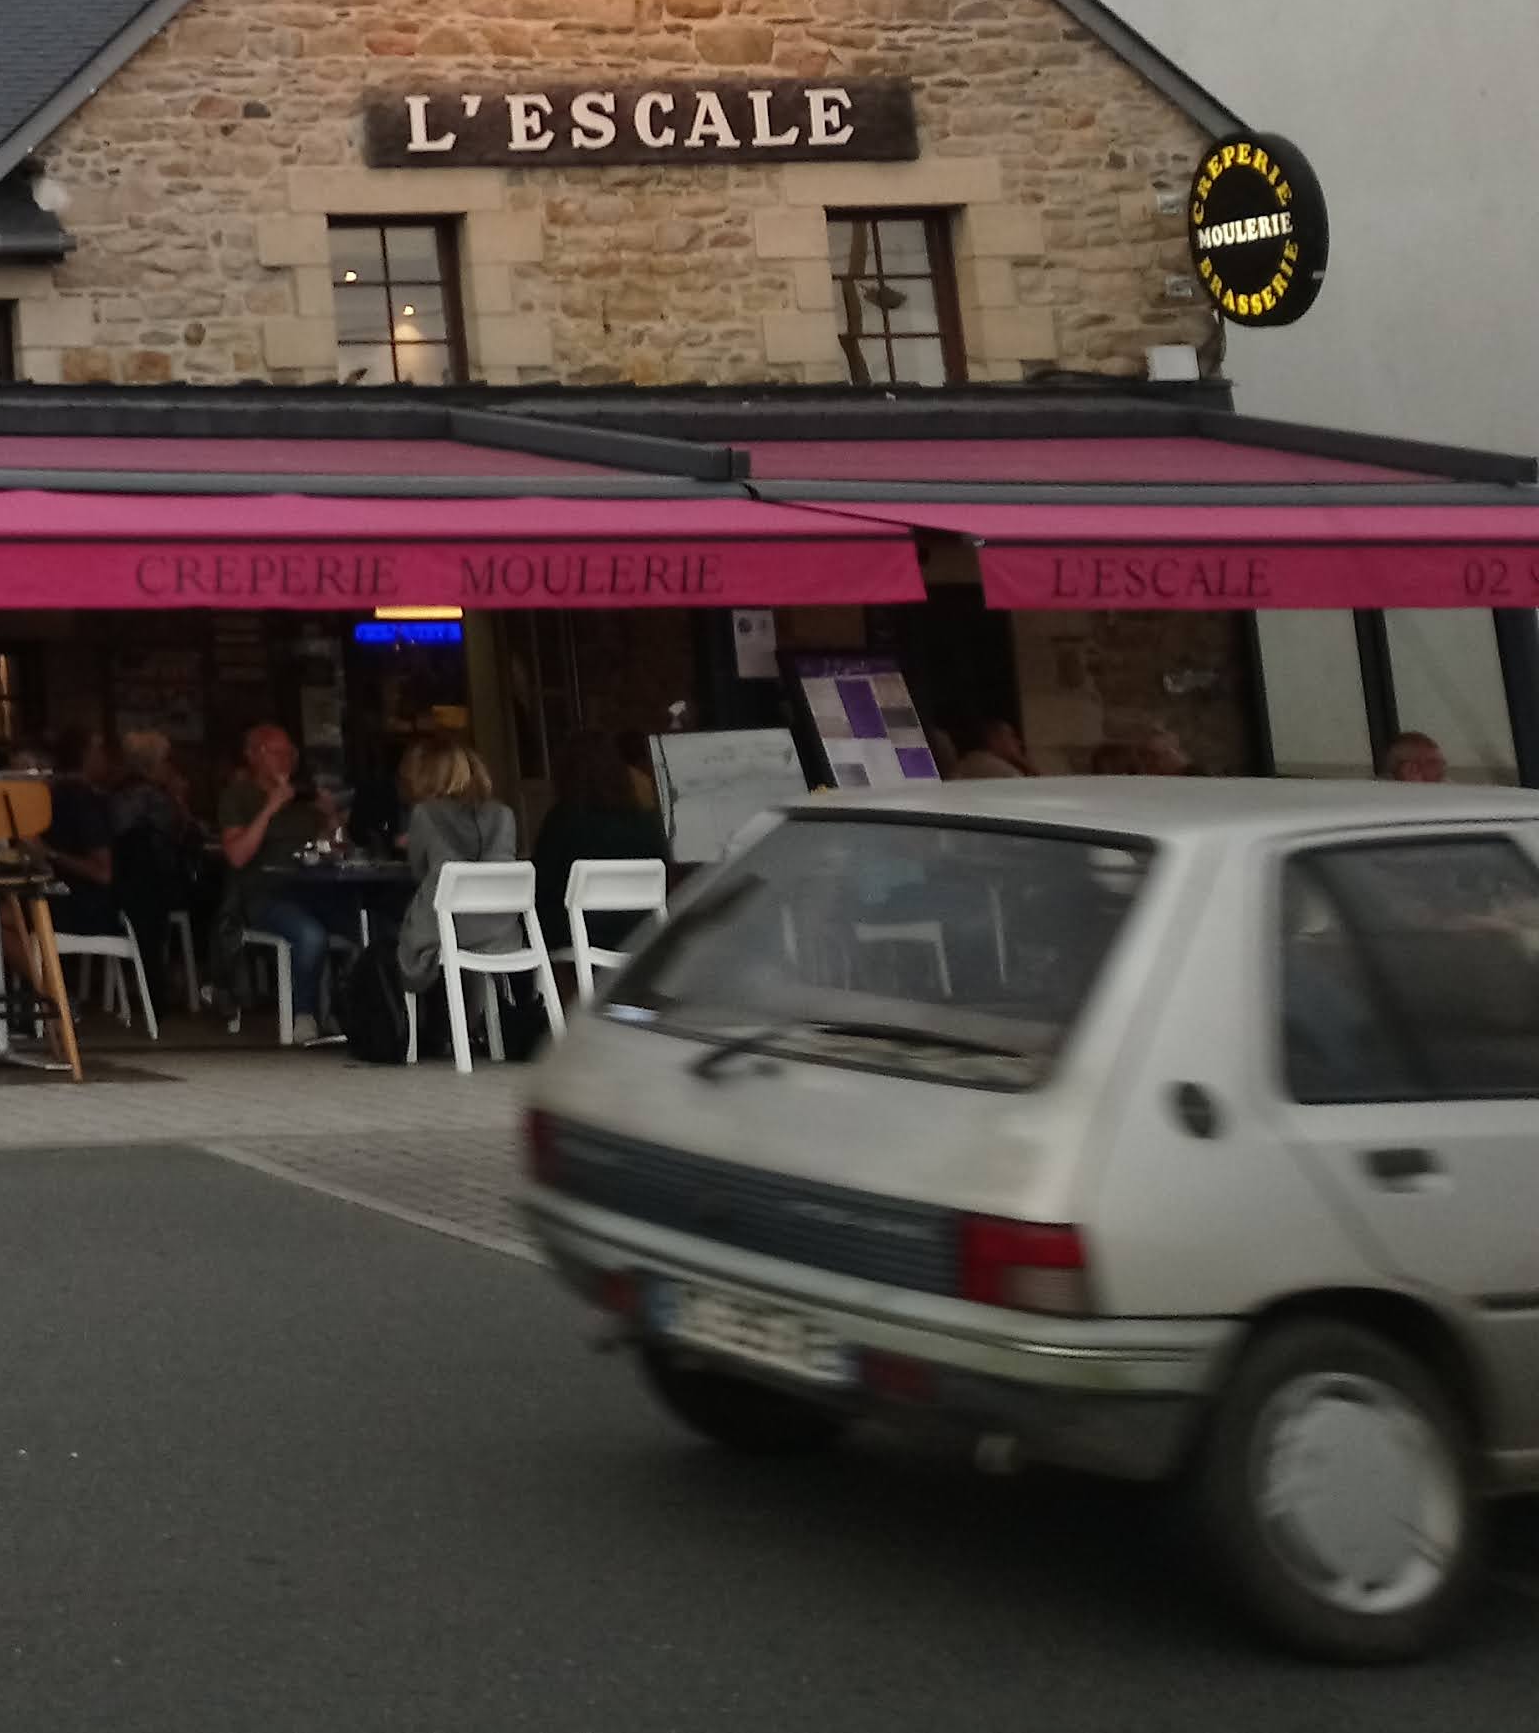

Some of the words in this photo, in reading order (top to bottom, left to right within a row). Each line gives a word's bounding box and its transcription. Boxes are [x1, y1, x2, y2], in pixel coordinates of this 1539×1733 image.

[405, 87, 855, 152] L'ESCALE
[1193, 143, 1293, 224] CREPERIE
[1197, 211, 1293, 249] MOULERIE
[1200, 239, 1298, 315] BRASSERIE
[135, 554, 400, 596] CREPERIE
[459, 553, 724, 595] MOULERIE
[1052, 555, 1272, 598] L'ESCALE
[1463, 558, 1512, 596] 02
